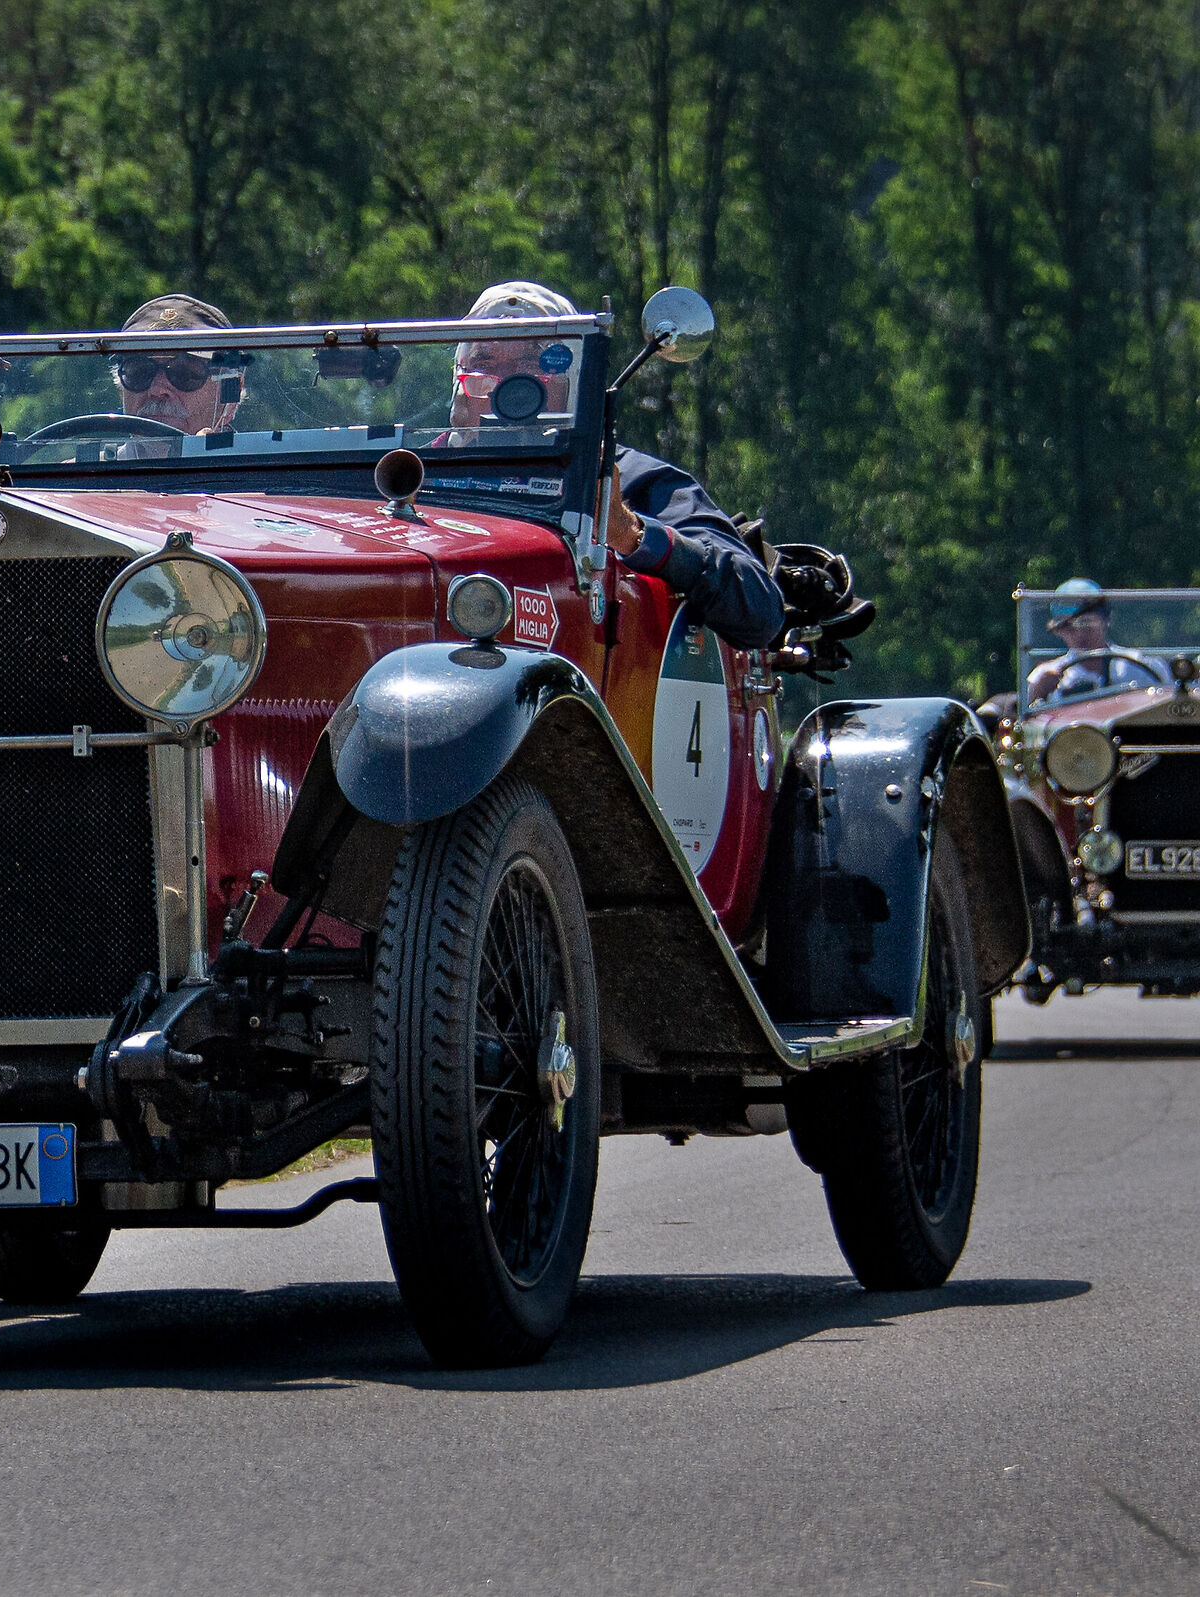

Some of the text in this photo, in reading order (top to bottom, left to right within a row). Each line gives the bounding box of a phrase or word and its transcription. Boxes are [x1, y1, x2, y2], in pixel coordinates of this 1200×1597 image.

[520, 596, 547, 616] 1000
[518, 619, 548, 639] MIGLIA
[686, 701, 702, 777] 4
